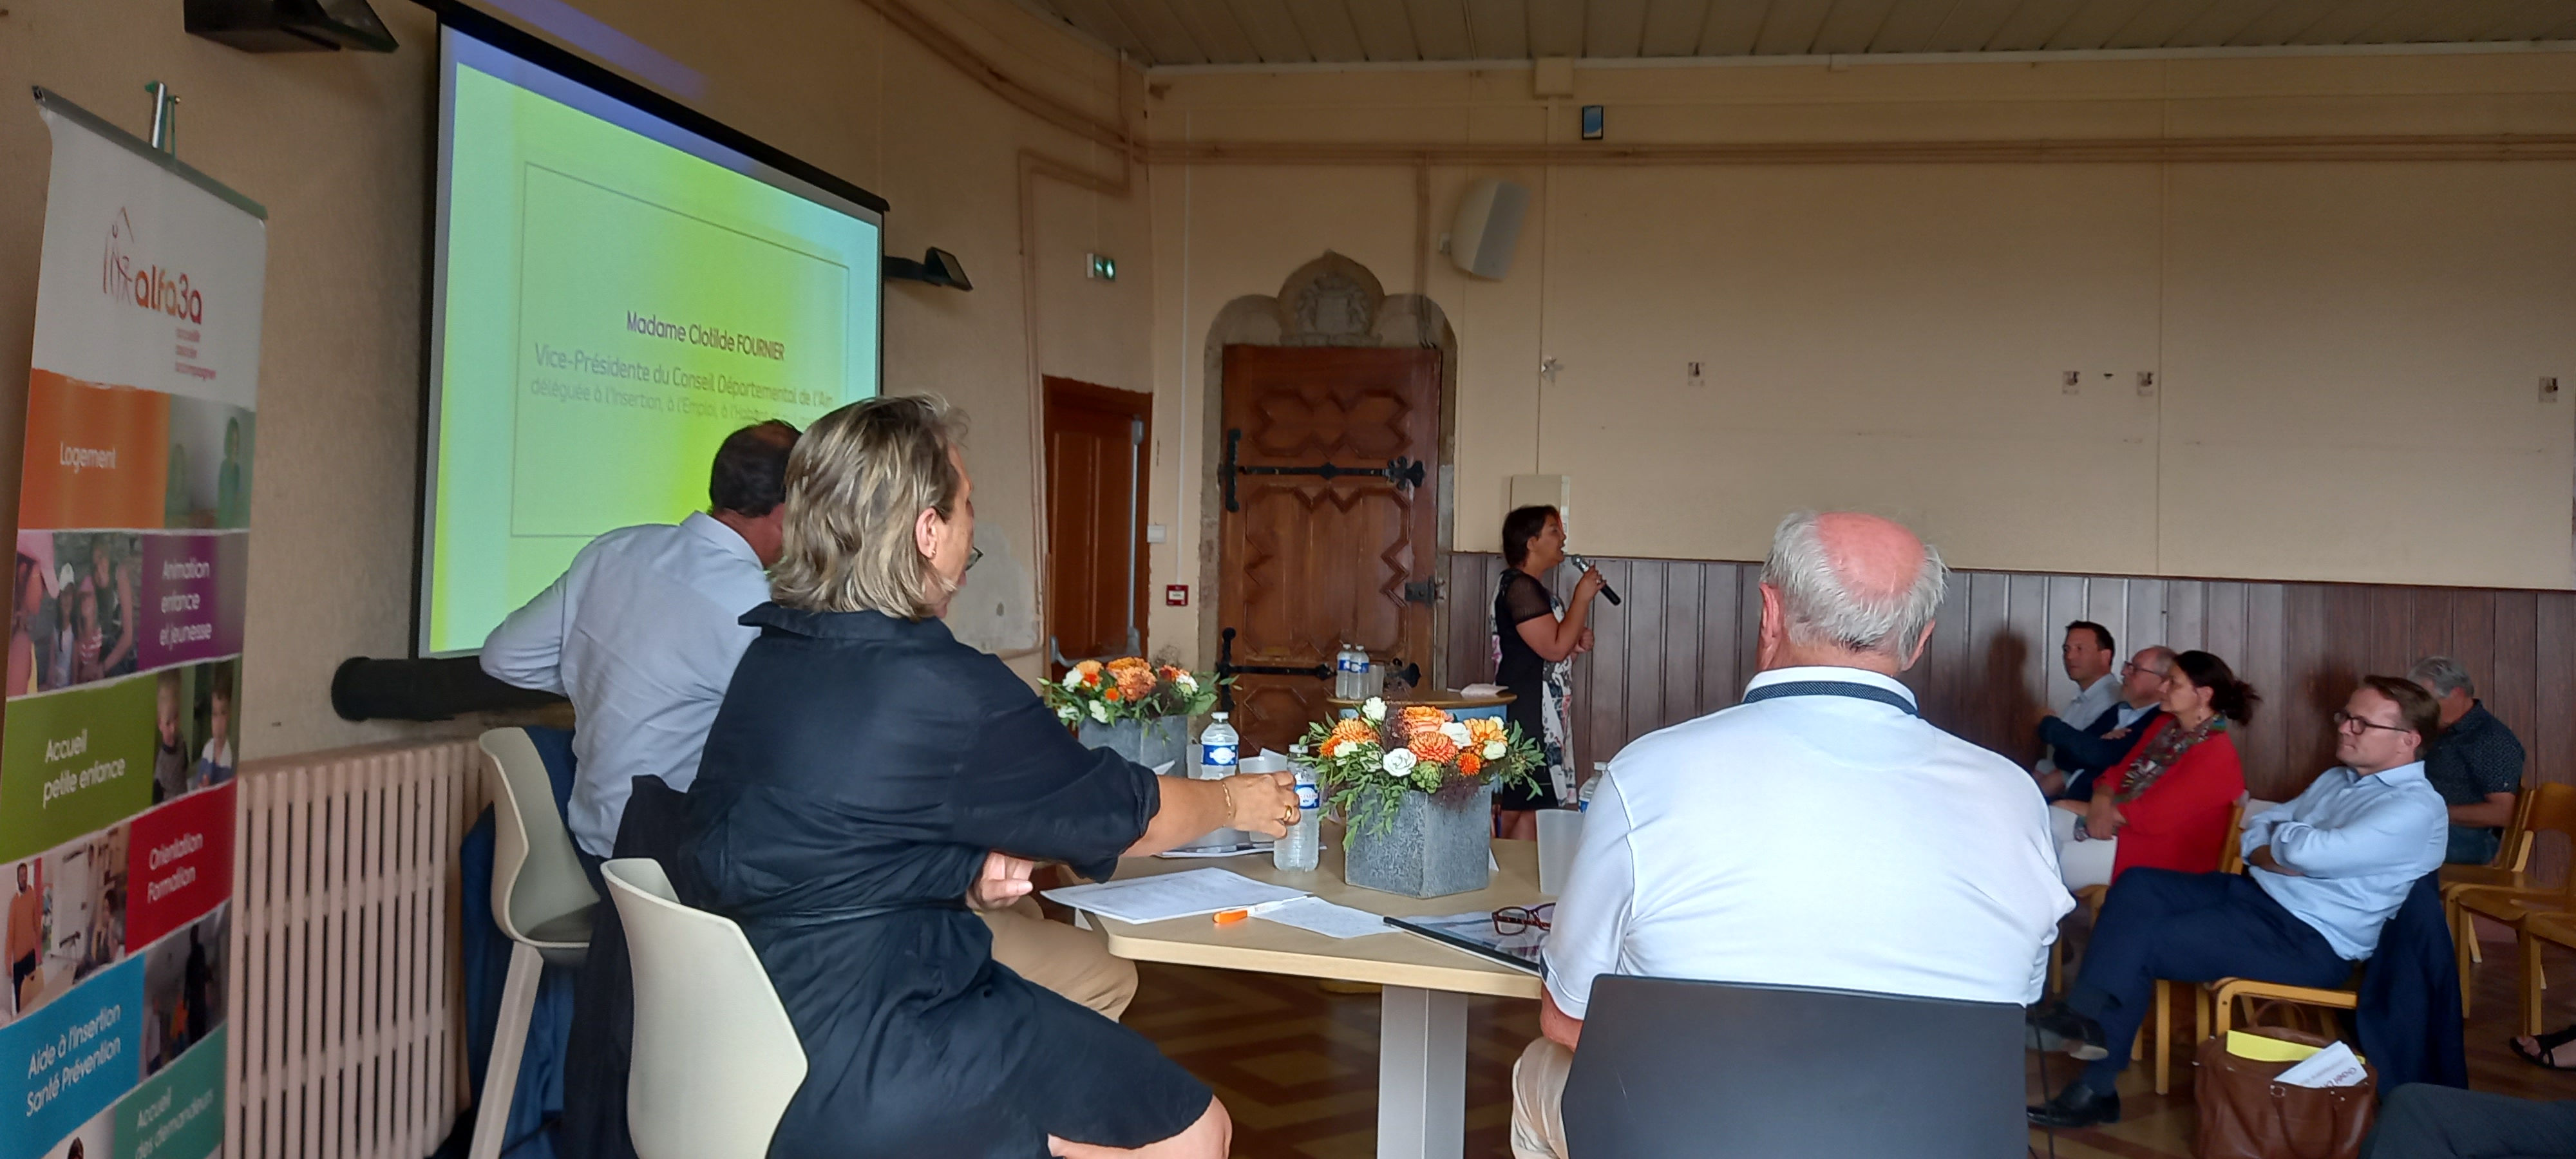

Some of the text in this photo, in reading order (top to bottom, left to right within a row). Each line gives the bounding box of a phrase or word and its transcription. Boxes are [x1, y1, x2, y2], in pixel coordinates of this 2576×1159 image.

[135, 264, 202, 325] alfa3a
[626, 310, 785, 361] Madame Clotilde FOURNIER
[531, 377, 591, 403] déléguée
[594, 384, 602, 402] à
[667, 395, 675, 412] à
[535, 342, 650, 382] Vice-Présidente
[653, 364, 669, 385] du
[673, 366, 715, 392] Conseil
[717, 374, 797, 404] Départemental
[799, 387, 811, 406] de
[60, 440, 116, 474] Logement
[162, 558, 210, 580] Animation
[162, 590, 200, 614] enfance
[168, 622, 212, 652] jeunesse
[44, 728, 88, 764] Accueil
[43, 757, 126, 809] petite enfance
[149, 833, 204, 871] Orientation
[147, 865, 196, 903] Formation
[26, 1037, 121, 1117] Santé Prévention
[28, 1043, 56, 1079] Aide
[58, 1034, 66, 1059] à
[136, 1086, 172, 1132] Accueil
[155, 1088, 214, 1148] demandeurs
